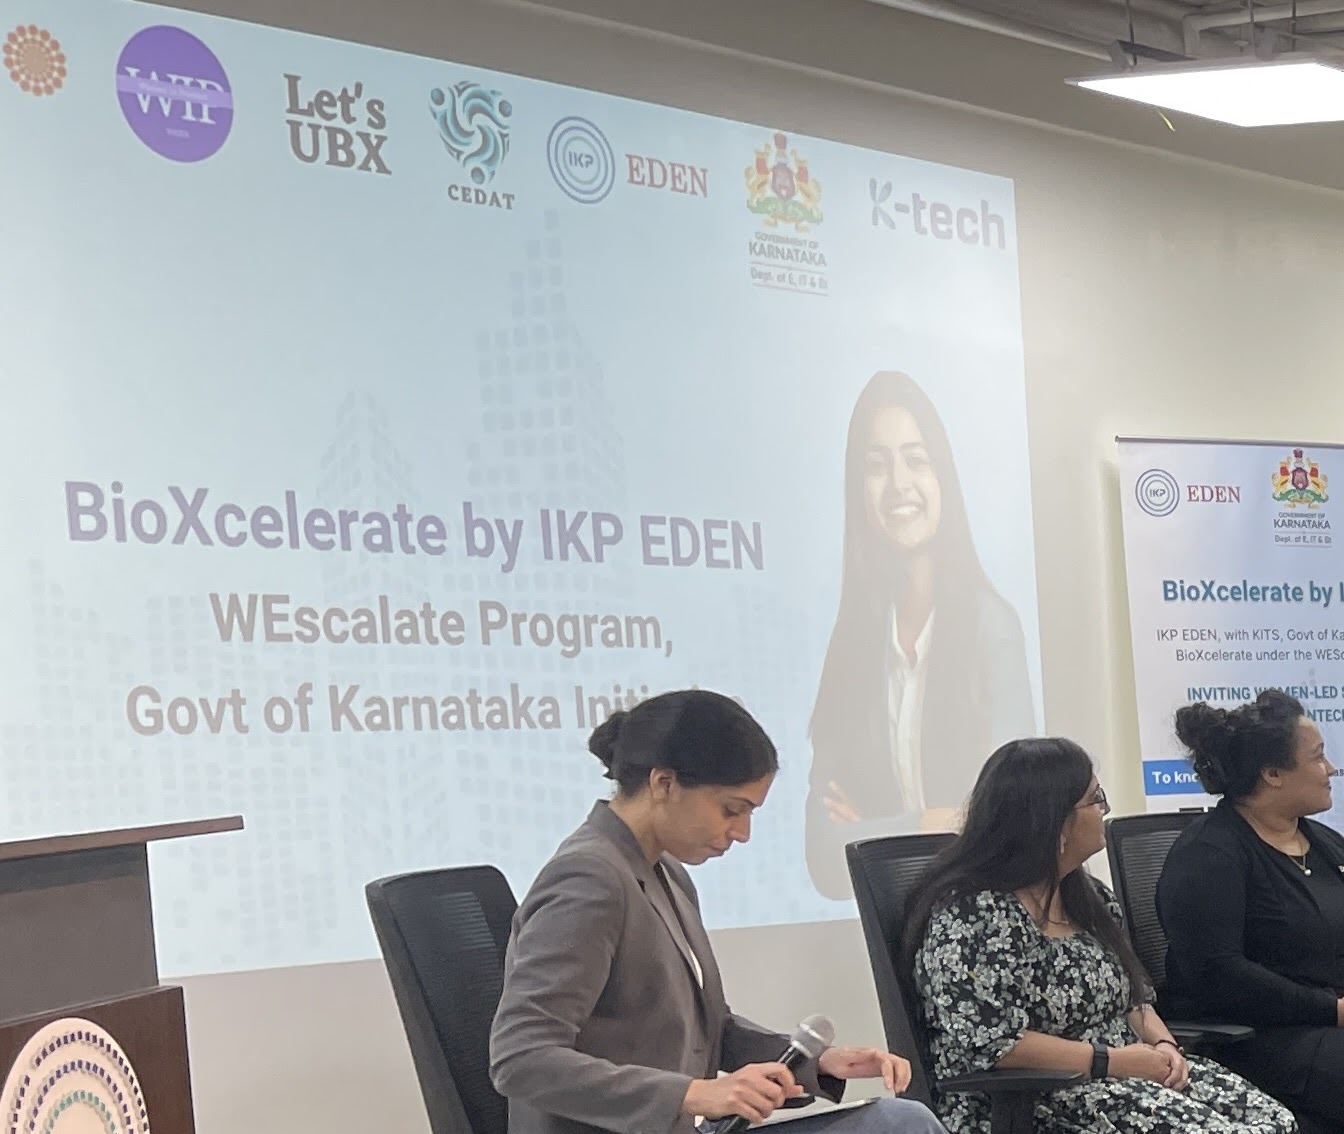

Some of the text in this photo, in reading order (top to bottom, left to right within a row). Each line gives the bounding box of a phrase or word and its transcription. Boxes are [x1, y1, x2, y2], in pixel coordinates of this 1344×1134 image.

[283, 73, 387, 130] Let's
[285, 119, 392, 175] UBX
[568, 151, 594, 169] IKP
[624, 153, 709, 198] EDEN
[447, 184, 515, 210] CEDAT
[868, 178, 1006, 250] K-tech
[748, 240, 827, 266] KARNATAKA
[1186, 485, 1241, 504] EDEN
[65, 481, 765, 574] BioXcelerate by IKP EDEN
[1274, 519, 1331, 529] KARNATAKA
[1163, 580, 1304, 602] BioXcelerate
[1309, 580, 1332, 608] by
[209, 592, 673, 658] WEscalate Program,
[1156, 629, 1178, 641] IKP
[1182, 628, 1220, 643] EDEN,
[1224, 629, 1249, 641] with
[1252, 628, 1284, 642] KITS,
[1287, 629, 1314, 641] Govt
[1318, 629, 1328, 641] of
[1176, 649, 1252, 661] BioXcelerate
[1256, 650, 1290, 661] under
[1294, 649, 1312, 660] the
[1187, 687, 1250, 700] INVITING
[126, 684, 250, 737] Govt
[263, 682, 313, 734] of
[328, 682, 561, 732] Karnataka
[1152, 770, 1198, 784] To kno
